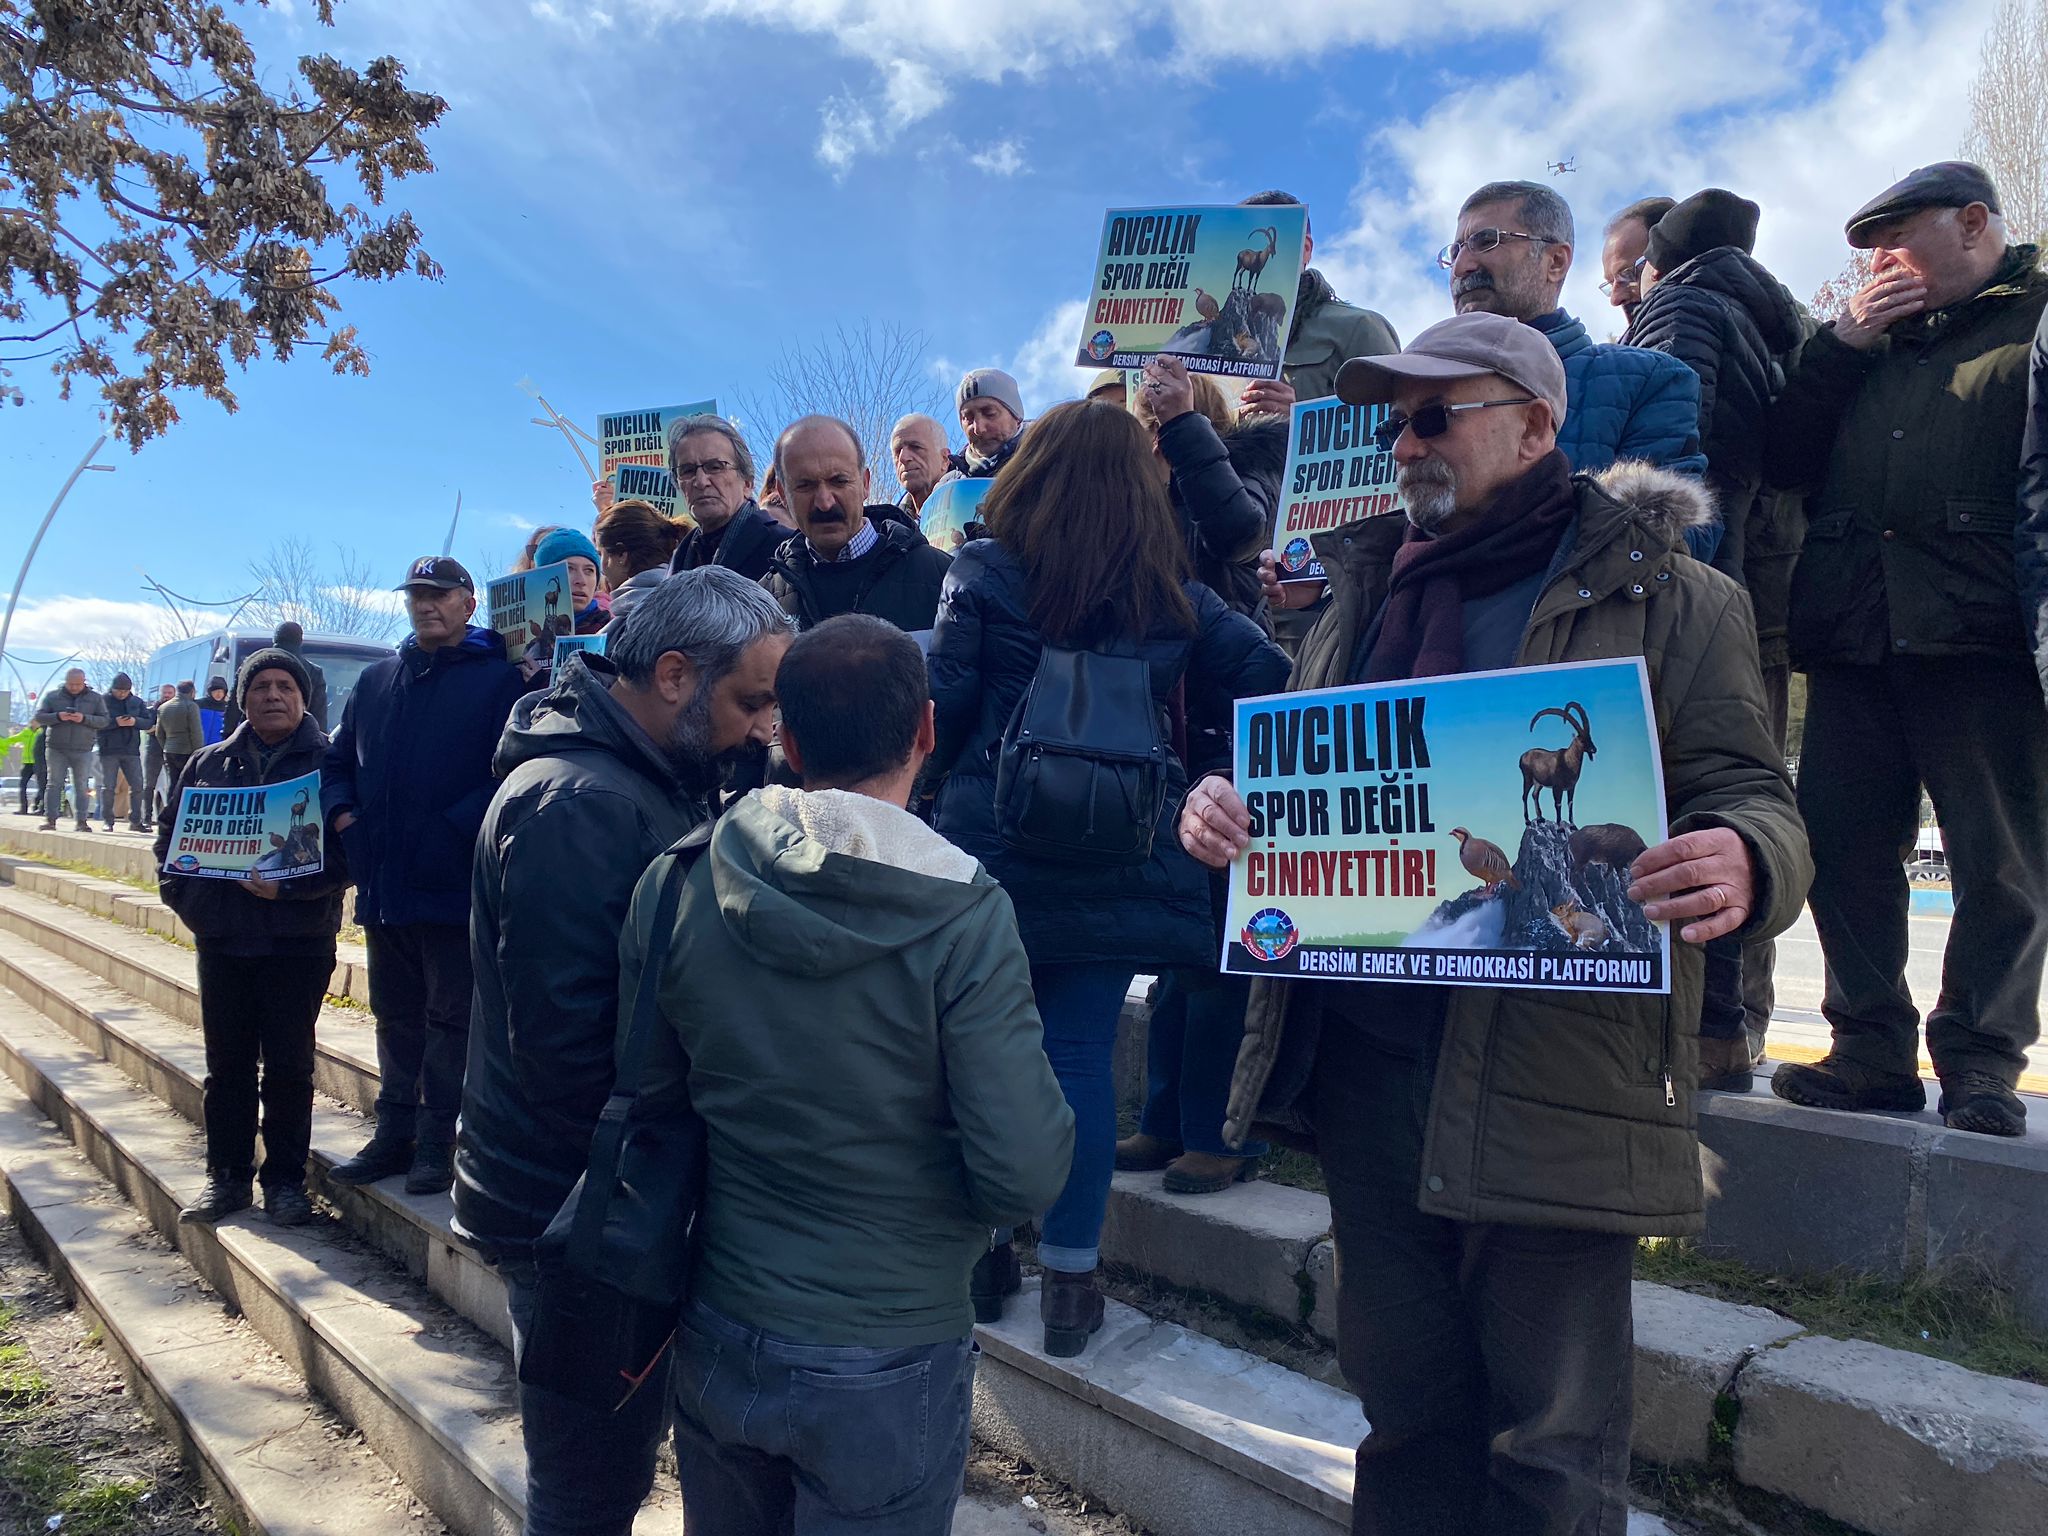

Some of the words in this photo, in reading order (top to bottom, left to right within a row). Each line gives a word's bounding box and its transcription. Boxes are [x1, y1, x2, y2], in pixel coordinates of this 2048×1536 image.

[1107, 215, 1201, 256] AVCILIK
[1101, 262, 1143, 290] SPOR
[1145, 256, 1191, 289] DEĞİL
[1094, 292, 1185, 324] CİNAYETTİR!
[1112, 352, 1140, 366] DERSİM
[1222, 361, 1274, 377] PLATFORMU
[604, 412, 662, 437] AVCILIK
[604, 439, 631, 455] SPOR
[635, 433, 663, 451] DEĞİL
[1293, 458, 1345, 494] SPOR
[491, 577, 526, 610] AVCILIK
[1248, 697, 1431, 779] AVCILIK
[187, 791, 267, 816] AVCILIK
[1246, 788, 1329, 838] SPOR
[1340, 772, 1435, 835] DEĞİL
[183, 818, 222, 835] SPOR
[227, 815, 263, 836] DEĞİL
[178, 834, 262, 855] CİNAYETTİR!
[1247, 839, 1436, 897] CİNAYETTİR!
[1300, 947, 1356, 973] DERSİM
[1362, 953, 1405, 975] EMEK
[1409, 954, 1430, 976] VE
[1435, 953, 1534, 980] DEMOKRASİ
[1541, 958, 1651, 984] PLATFORMU
